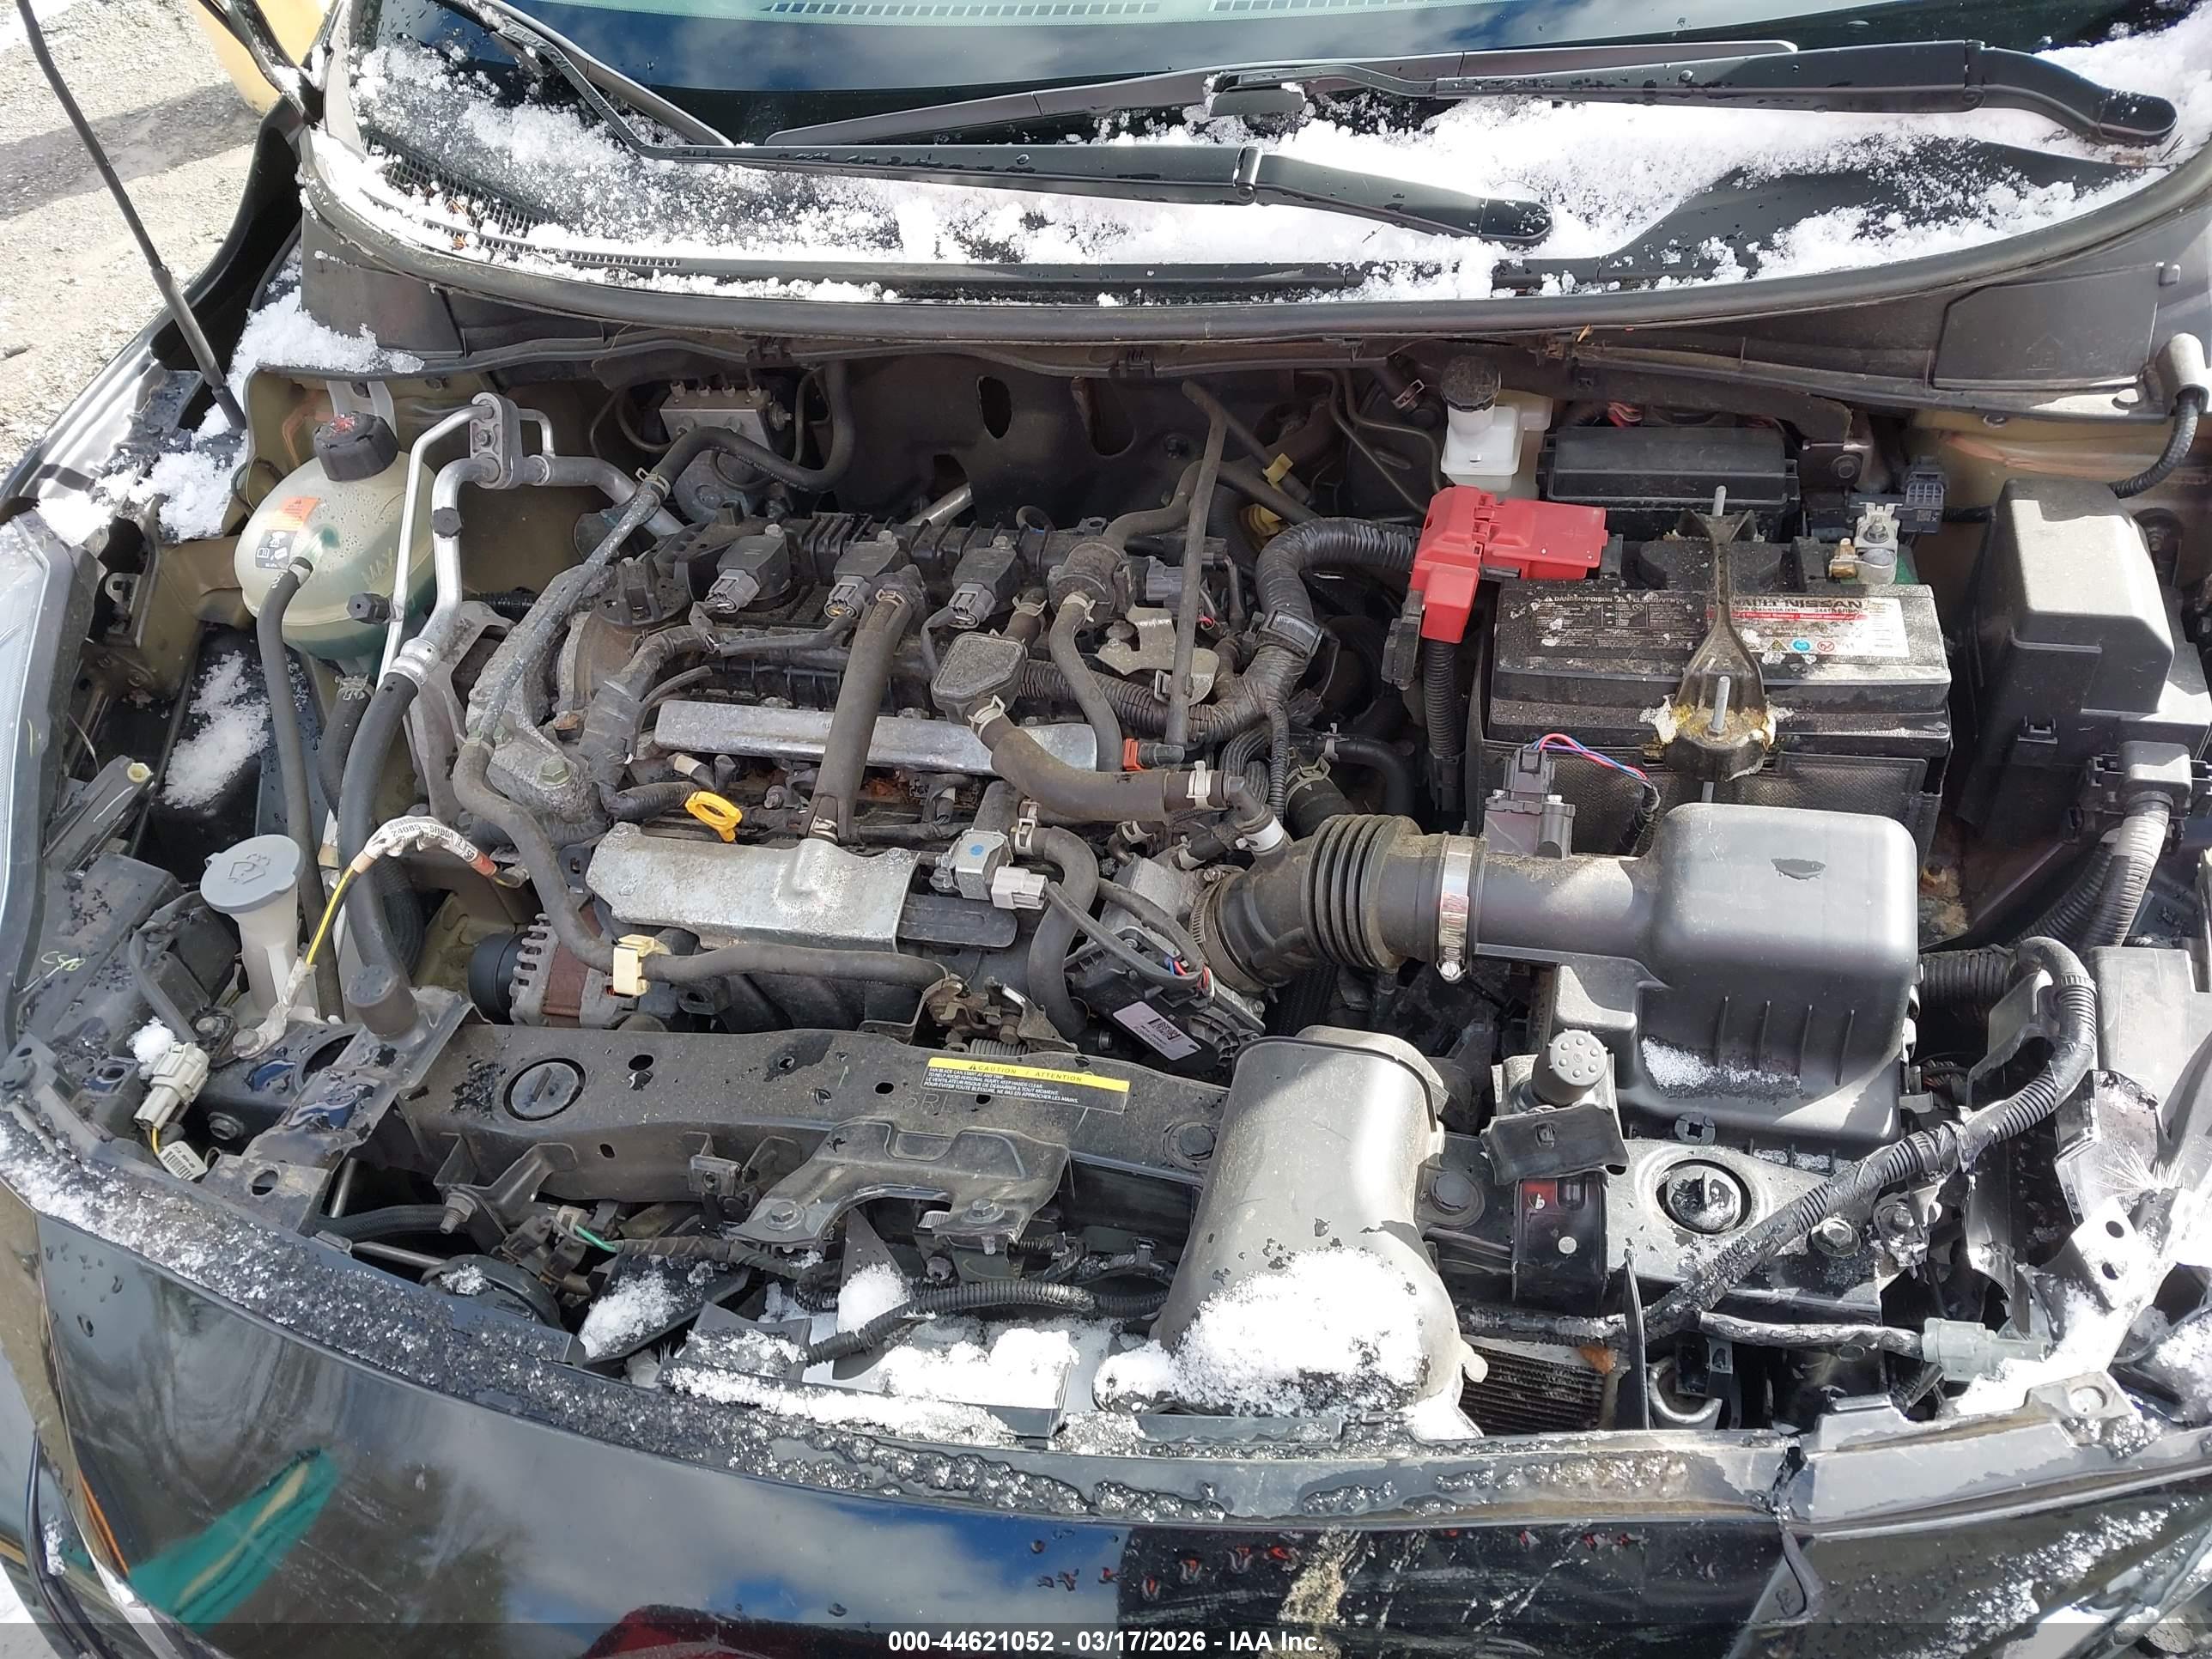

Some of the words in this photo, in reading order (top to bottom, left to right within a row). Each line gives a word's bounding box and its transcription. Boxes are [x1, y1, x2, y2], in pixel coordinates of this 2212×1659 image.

[1784, 599, 1862, 616] NISSAN
[1036, 1072, 1082, 1081] ATTENTION
[1022, 1091, 1052, 1100] APPROCHER
